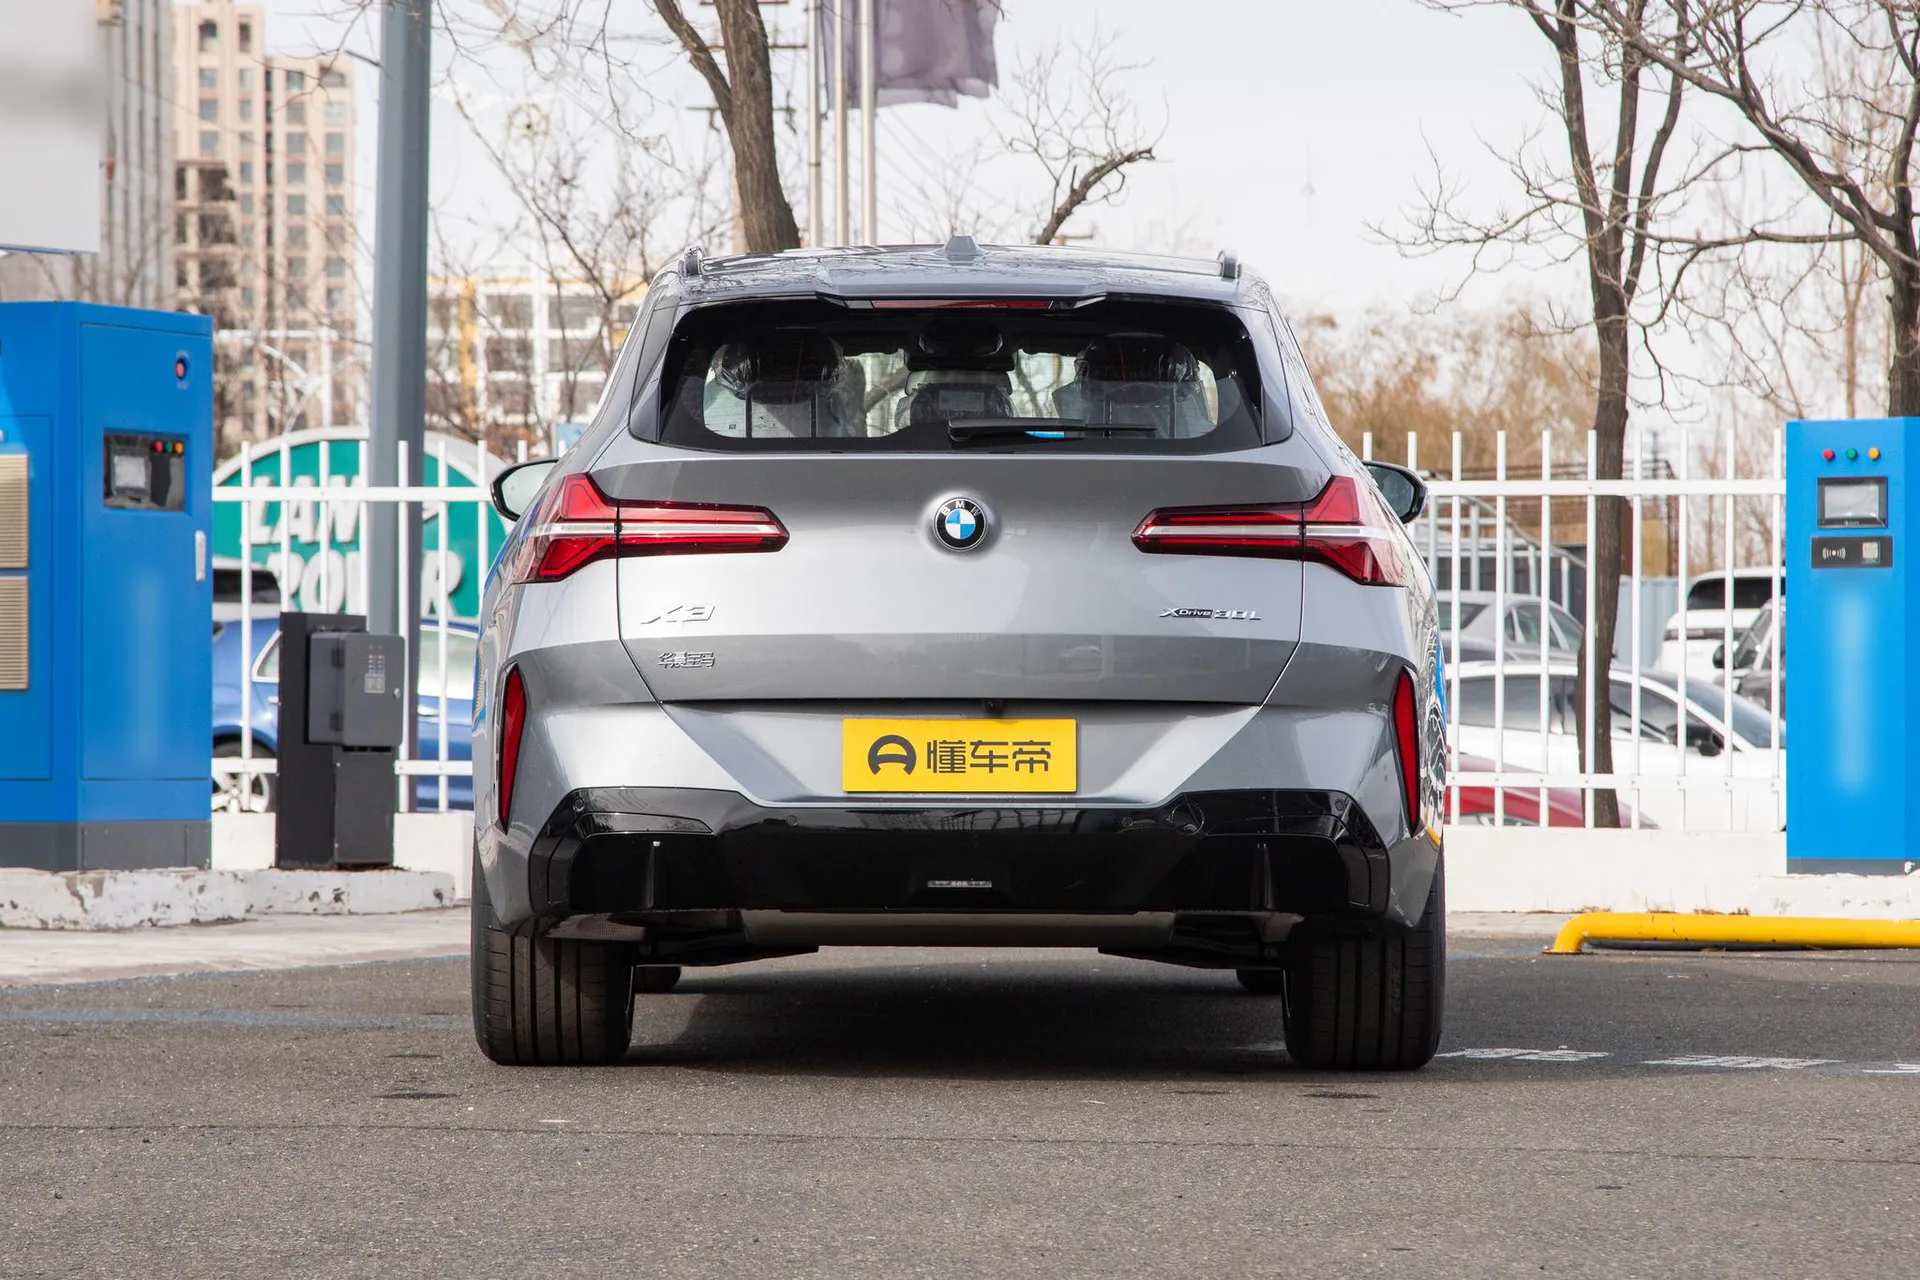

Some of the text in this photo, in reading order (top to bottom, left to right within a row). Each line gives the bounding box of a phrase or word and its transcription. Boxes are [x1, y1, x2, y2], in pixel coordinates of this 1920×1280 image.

[241, 474, 400, 545] LAN
[940, 499, 982, 517] BMW
[640, 603, 716, 625] X3
[657, 652, 716, 669] 华晨宝马
[926, 739, 1052, 774] 懂车帝
